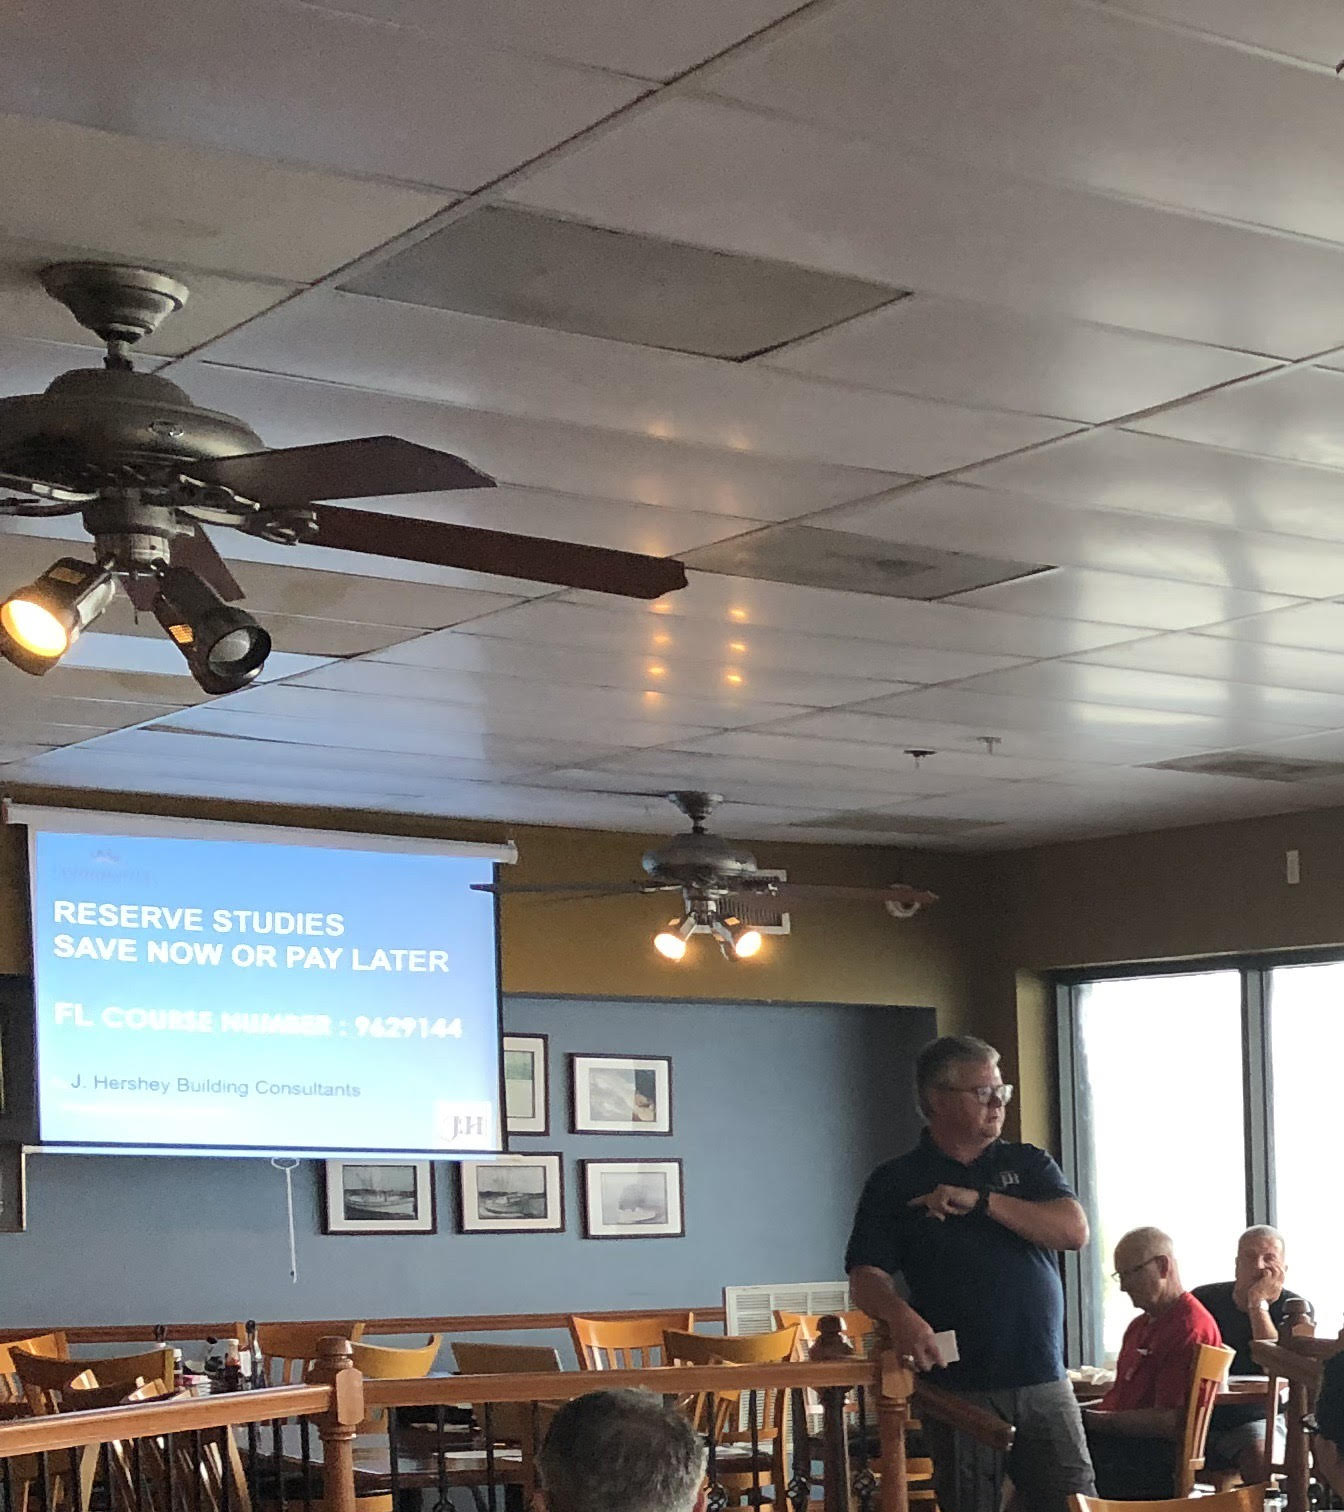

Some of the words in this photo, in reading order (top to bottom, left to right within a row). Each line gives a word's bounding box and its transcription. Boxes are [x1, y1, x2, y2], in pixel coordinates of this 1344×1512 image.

[53, 900, 204, 931] RESERVE
[212, 909, 345, 937] STUDIES
[53, 933, 138, 962] SAVE
[147, 940, 223, 966] NOW
[231, 944, 277, 968] OR
[286, 945, 343, 970] PAY
[352, 948, 450, 972] LATER
[54, 1002, 97, 1027] FL
[70, 1074, 87, 1089] J.
[94, 1075, 170, 1095] Hershey
[177, 1077, 249, 1098] Building
[255, 1080, 361, 1098] Consultants
